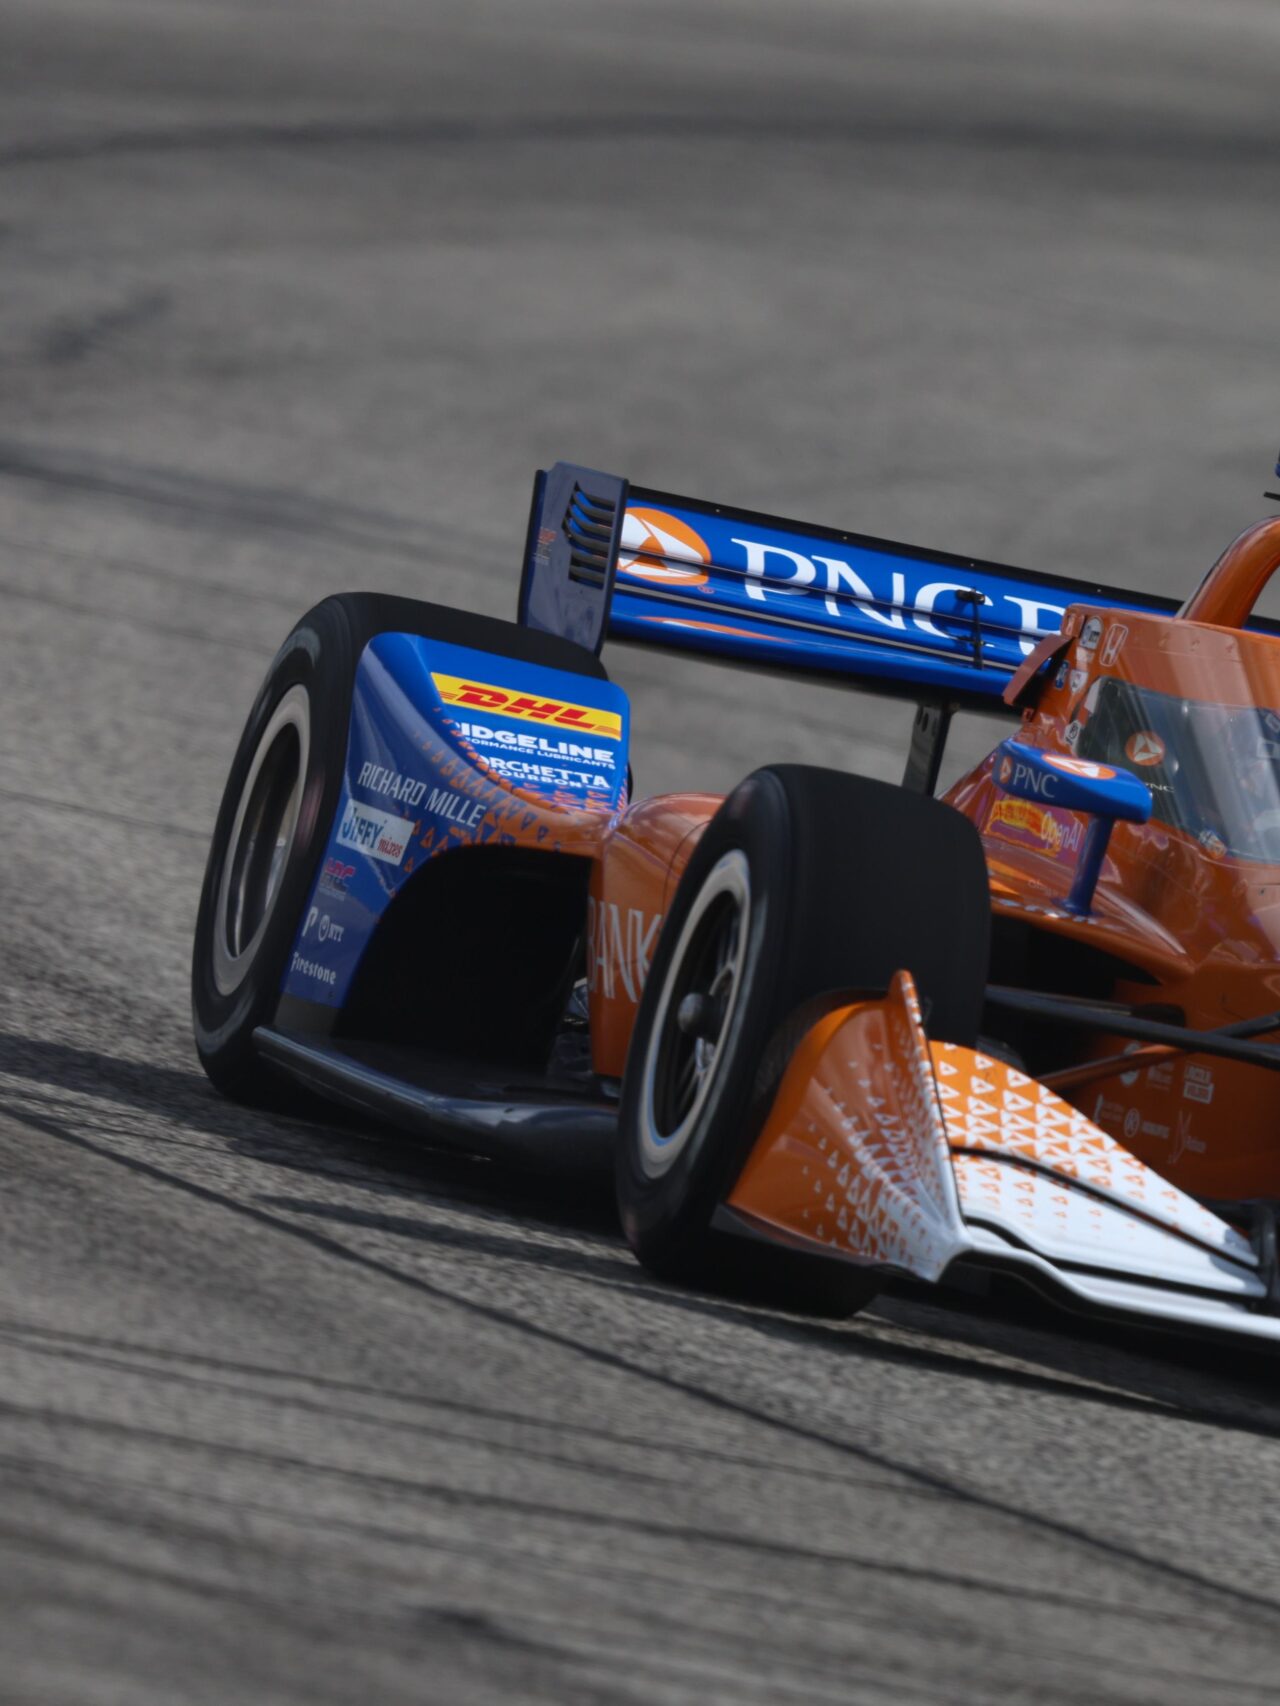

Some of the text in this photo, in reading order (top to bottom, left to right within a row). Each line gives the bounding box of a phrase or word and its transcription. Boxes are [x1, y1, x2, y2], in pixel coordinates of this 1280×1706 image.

[456, 684, 595, 729] DHL
[454, 721, 615, 763] IDGELINE
[537, 750, 616, 770] LUBRICANTS
[357, 761, 486, 828] RICHARD MILLE
[490, 768, 582, 788] OURBON
[1012, 763, 1058, 798] PNC
[290, 952, 336, 985] Firestone
